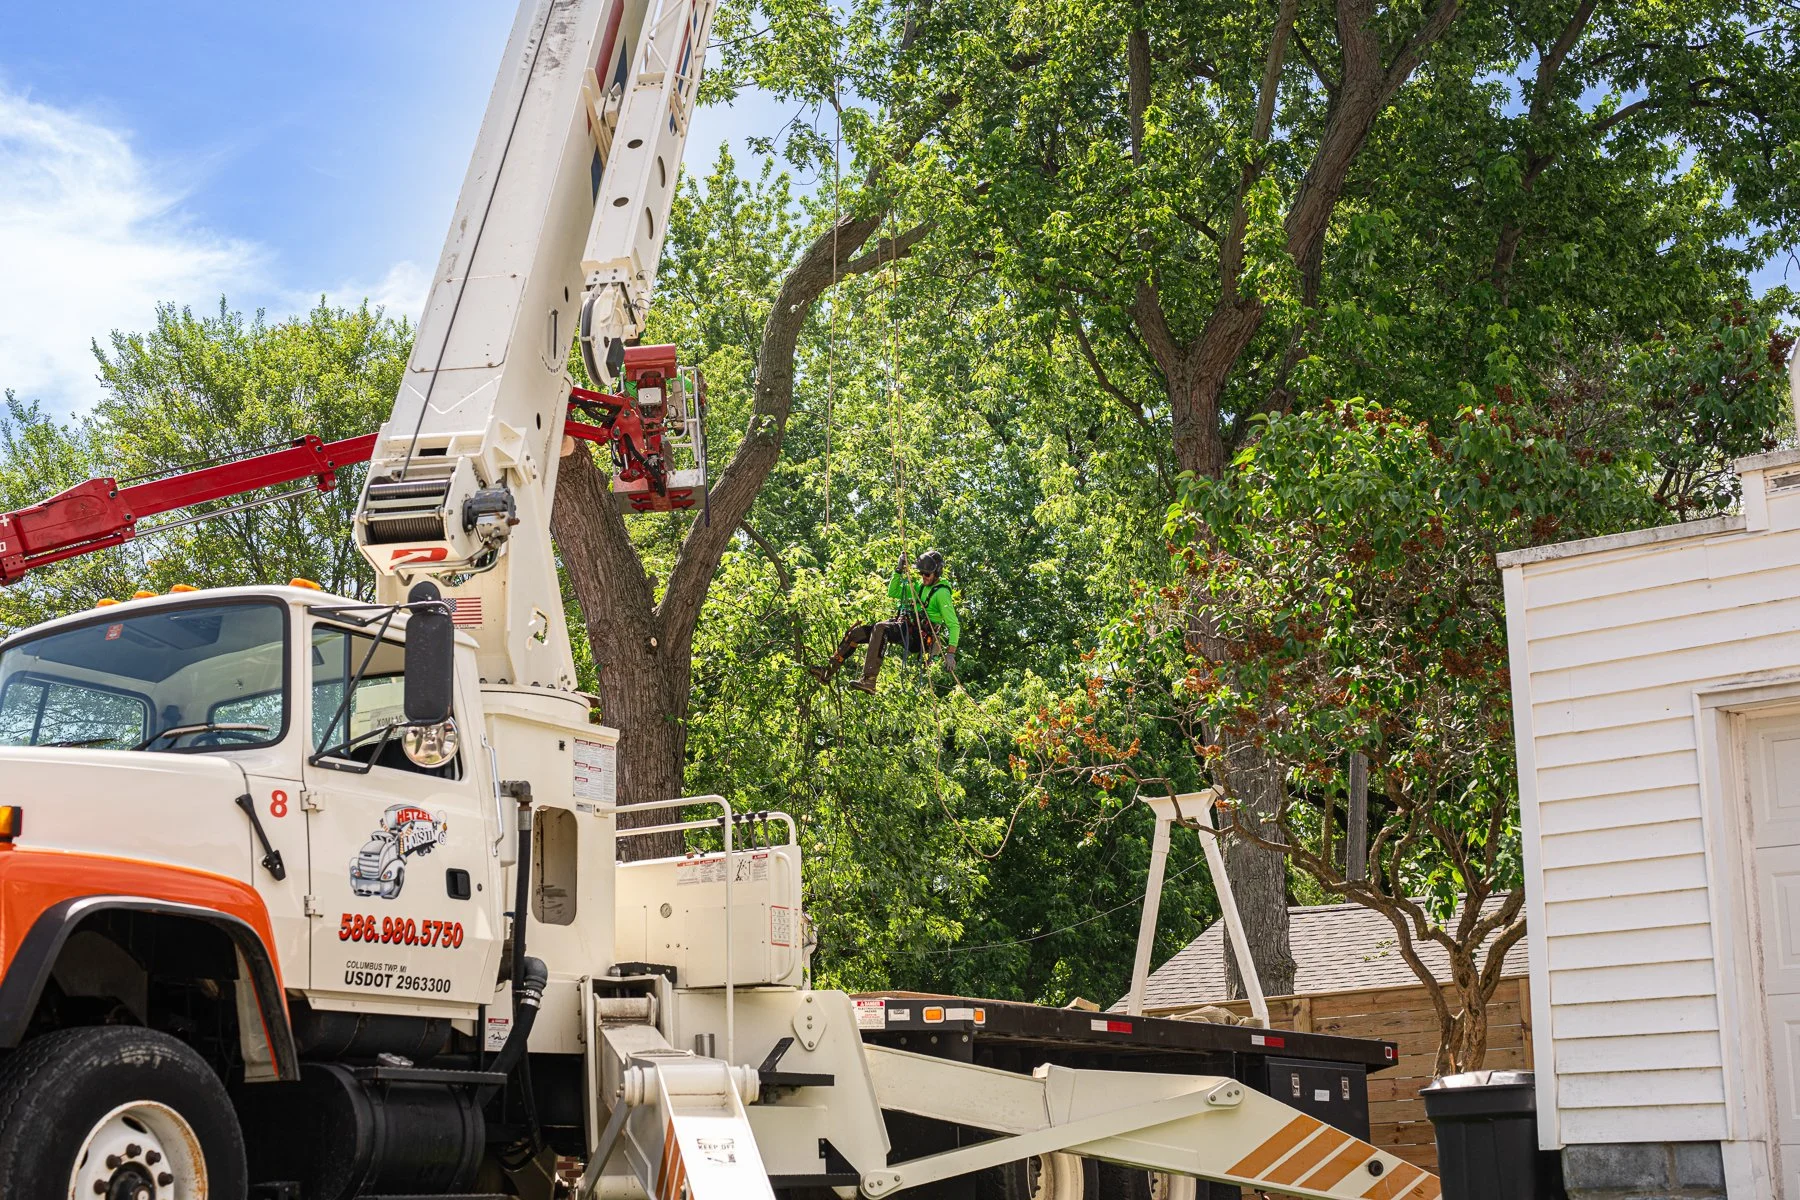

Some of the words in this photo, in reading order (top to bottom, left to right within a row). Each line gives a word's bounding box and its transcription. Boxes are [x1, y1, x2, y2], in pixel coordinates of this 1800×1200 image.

[270, 789, 288, 818] 8
[396, 808, 433, 826] HETZEL
[338, 913, 463, 948] 586.980.5750
[346, 960, 383, 971] COLUMBUS
[384, 963, 399, 973] TWP.
[399, 965, 407, 973] MI
[344, 970, 393, 988] USDOT
[396, 975, 451, 993] 2963300
